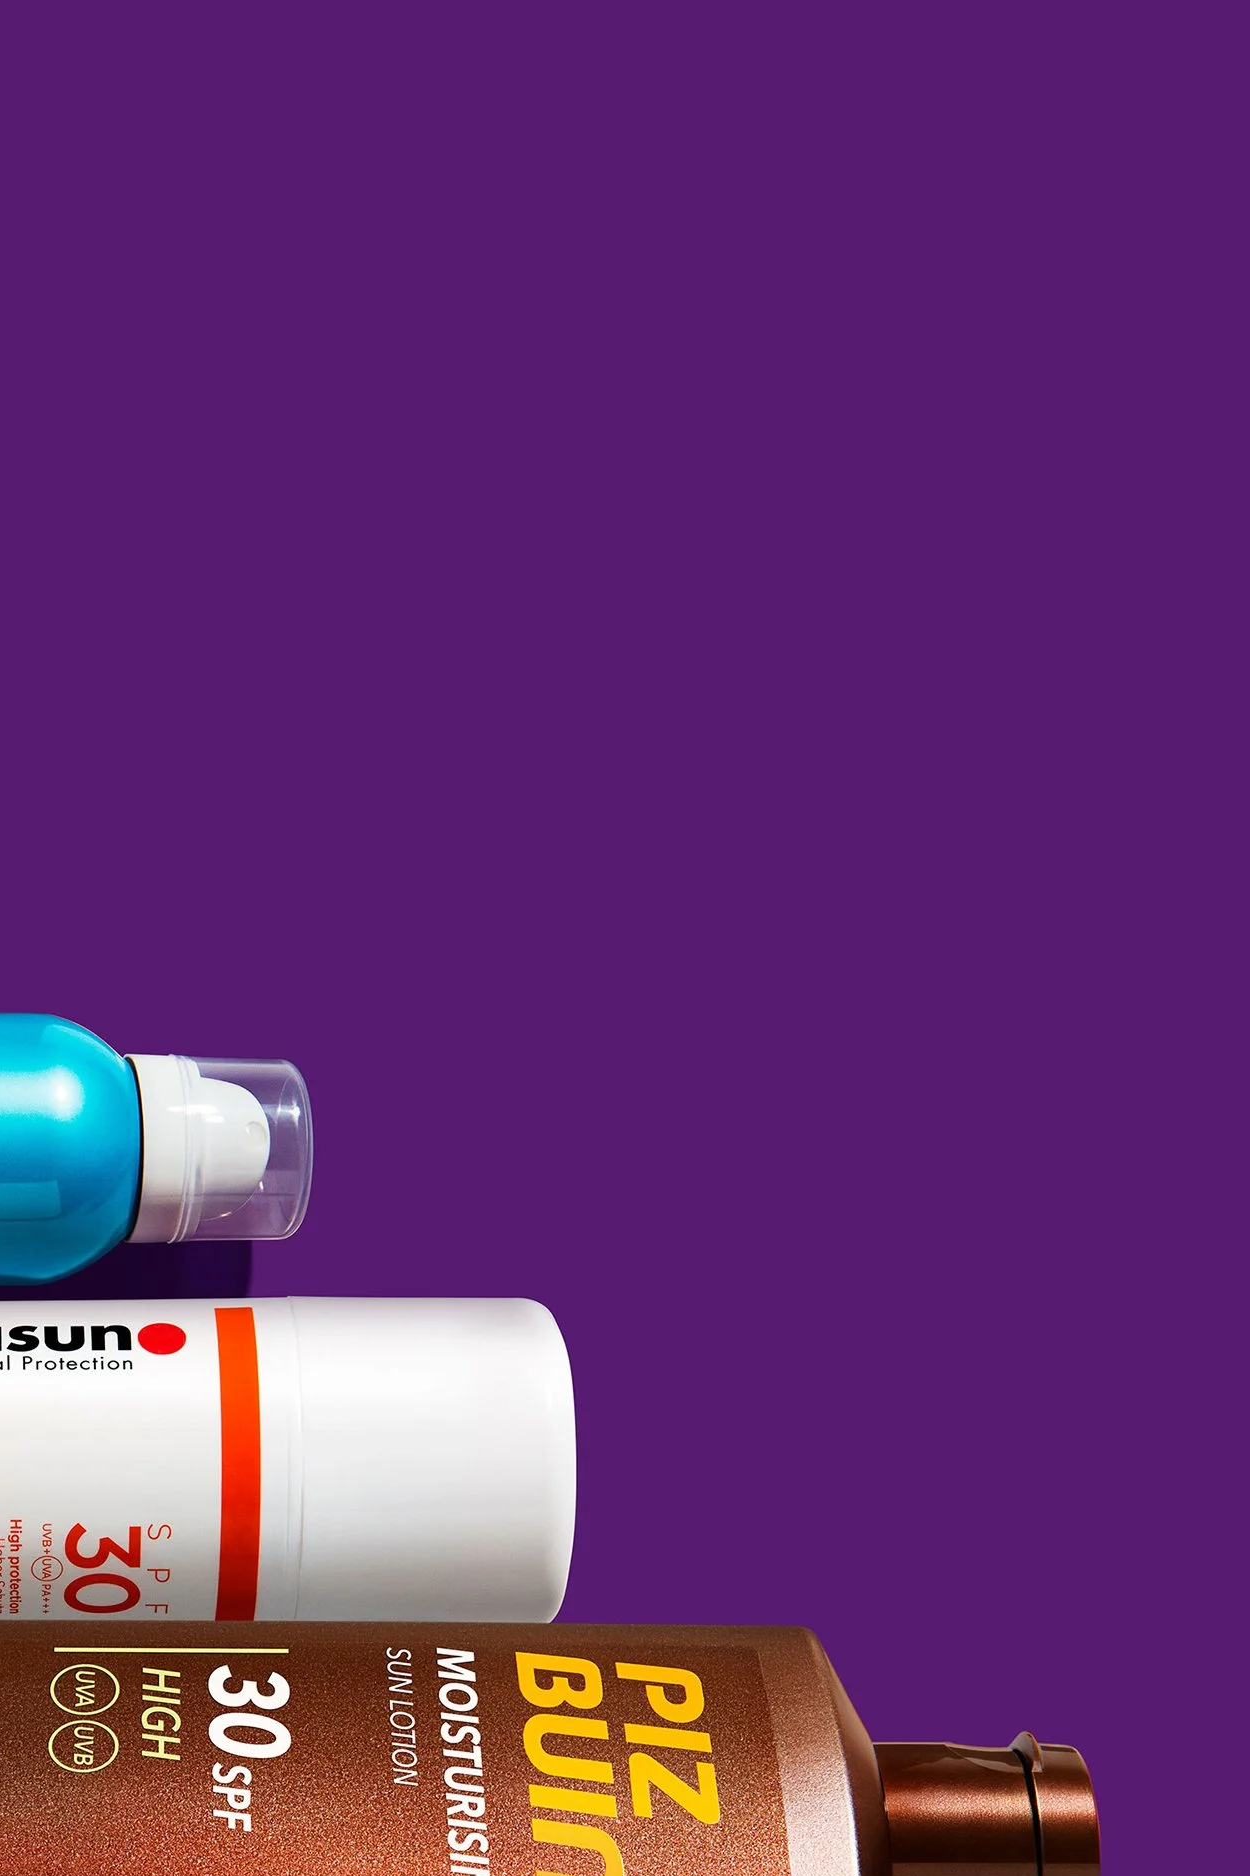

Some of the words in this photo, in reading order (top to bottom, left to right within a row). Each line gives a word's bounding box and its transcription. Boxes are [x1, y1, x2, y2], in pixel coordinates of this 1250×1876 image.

[22, 1356, 133, 1371] Protection
[8, 1519, 22, 1552] High
[8, 1556, 22, 1614] protection
[64, 1522, 141, 1614] 30
[73, 1670, 96, 1709] UVA
[386, 1647, 414, 1694] SUN
[141, 1666, 182, 1763] HIGH
[207, 1670, 292, 1759] 30
[614, 1661, 721, 1828] PIZ
[71, 1726, 94, 1766] UVB
[391, 1712, 418, 1788] LOTION
[210, 1768, 251, 1832] SPF
